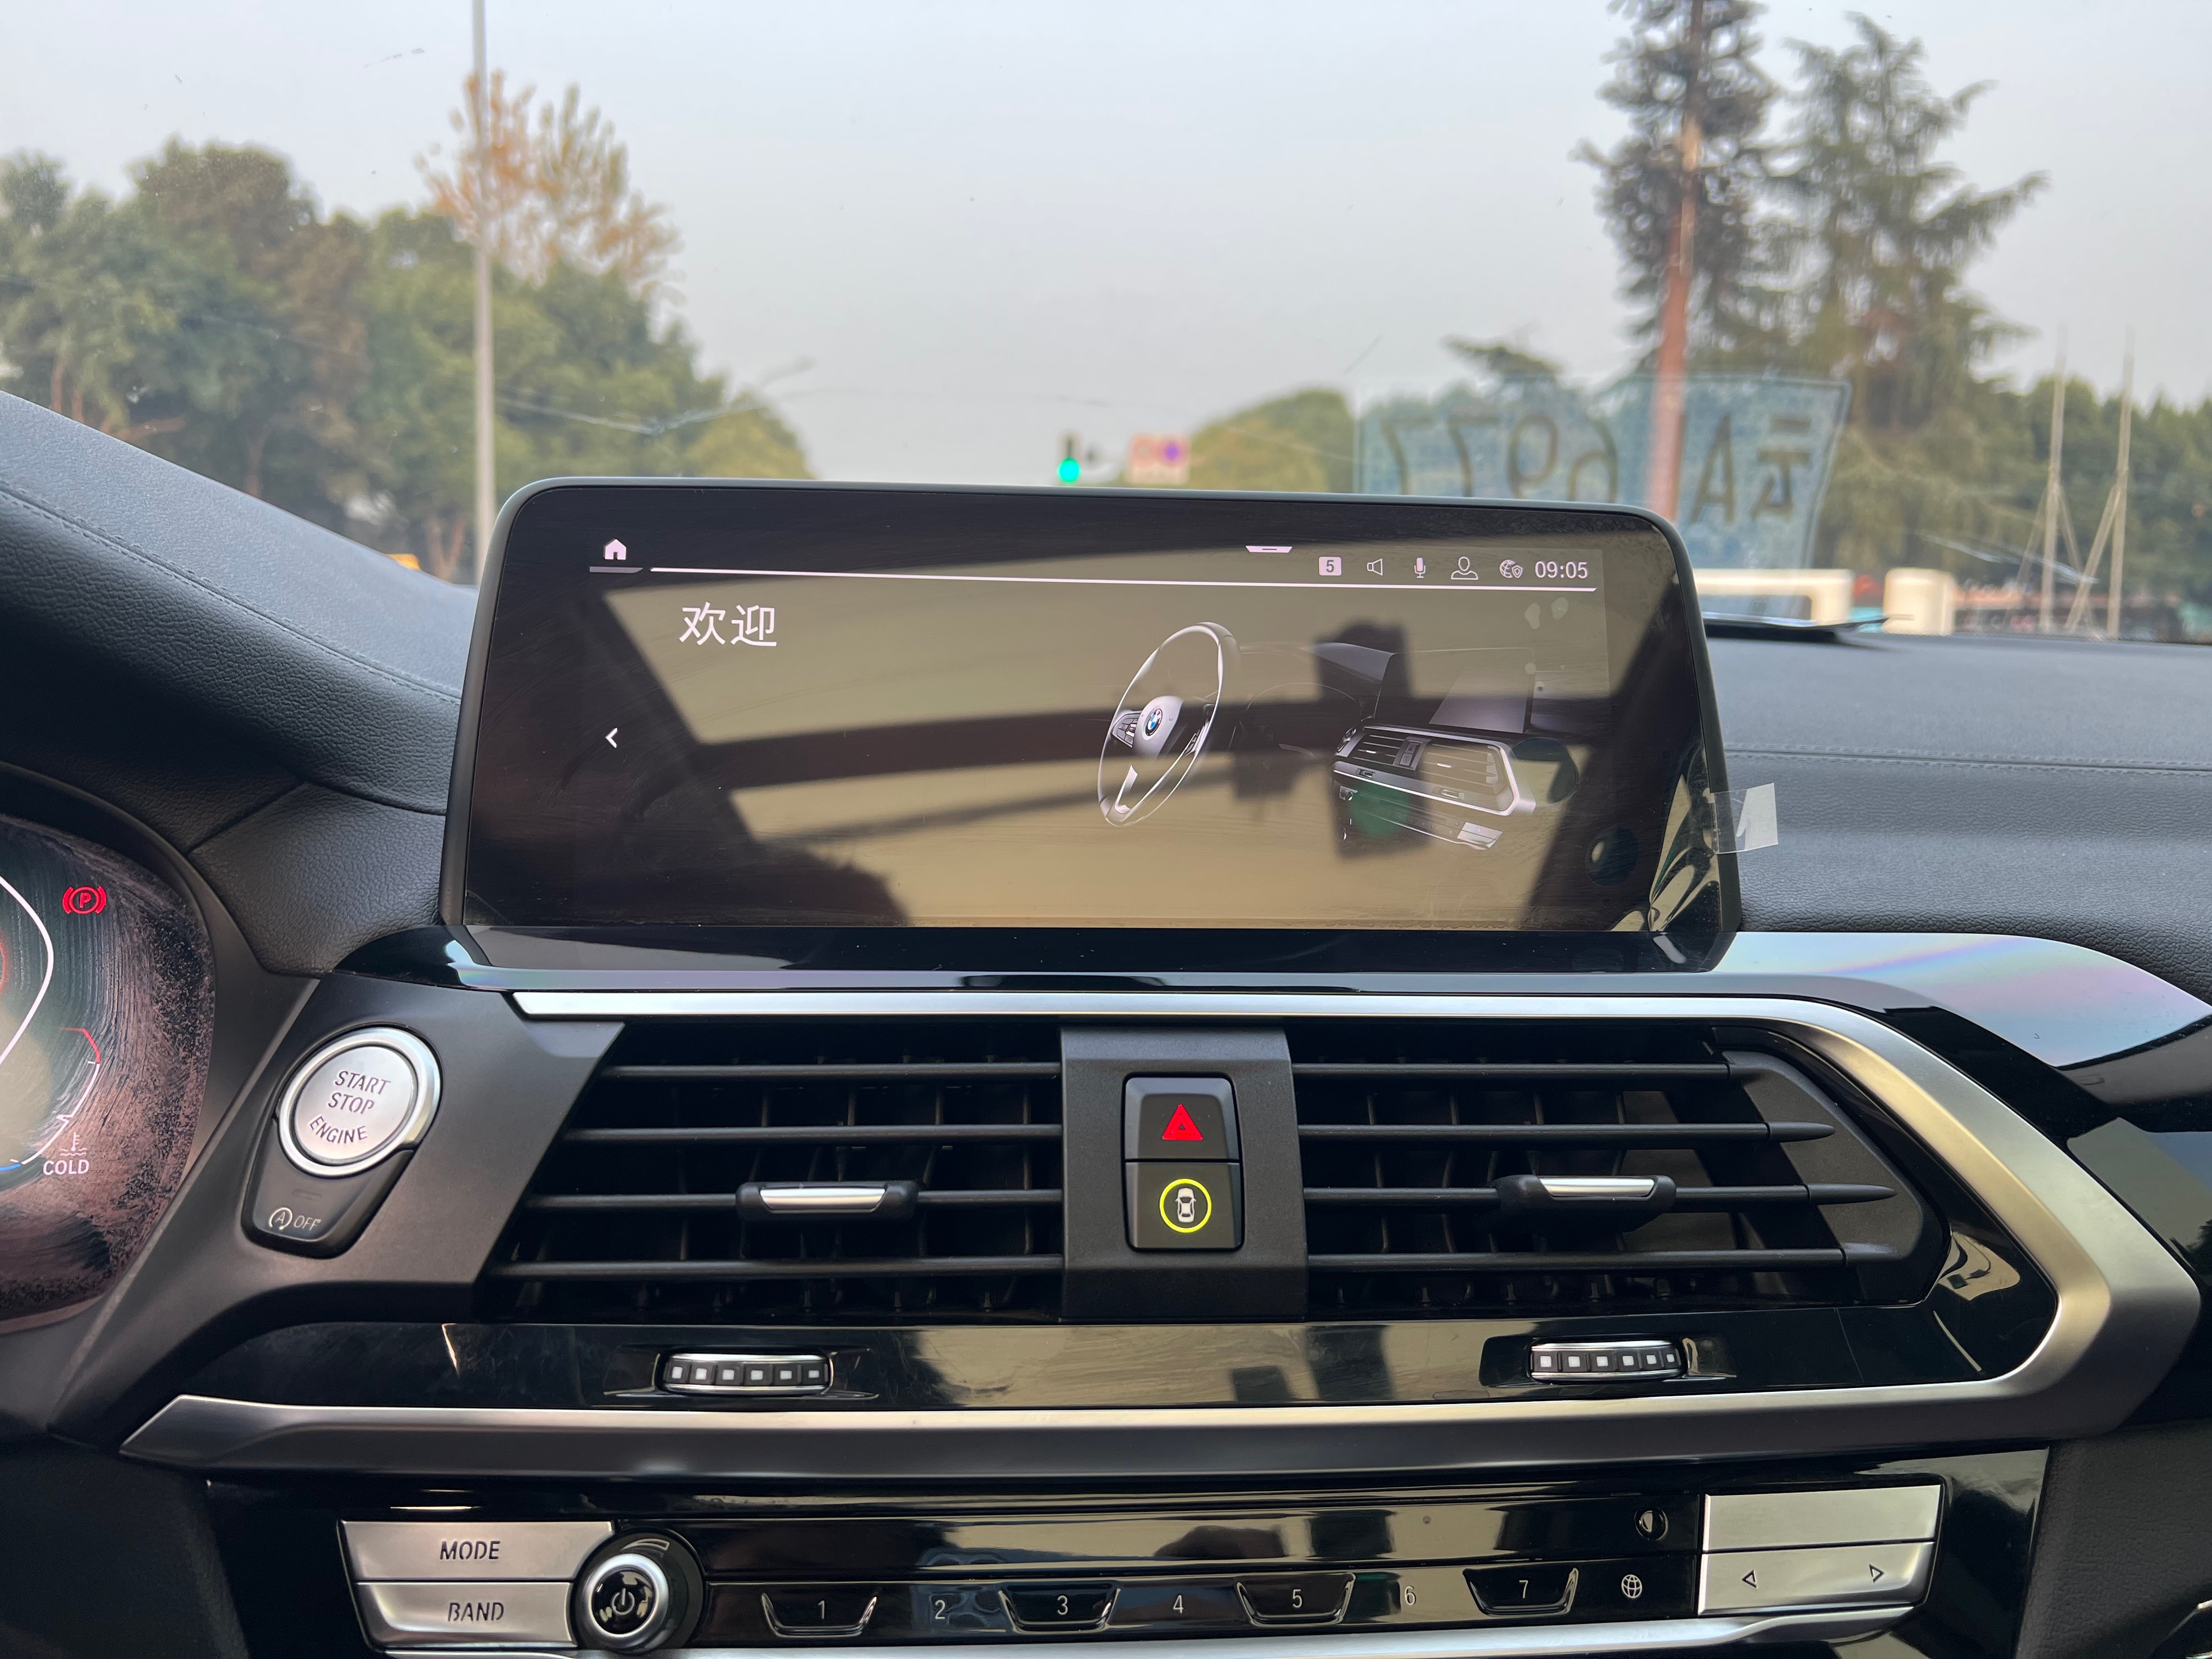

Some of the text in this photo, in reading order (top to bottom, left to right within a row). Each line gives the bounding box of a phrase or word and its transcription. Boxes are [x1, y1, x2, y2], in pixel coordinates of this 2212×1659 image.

[1326, 560, 1334, 573] 5
[1535, 561, 1588, 579] 09:05
[679, 601, 777, 647] 欢迎
[80, 892, 91, 909] P
[334, 1070, 391, 1095] START
[328, 1092, 375, 1115] STOP
[309, 1115, 368, 1144] ENGINE
[43, 1159, 90, 1176] COLD
[275, 1211, 322, 1231] A OFF
[440, 1541, 501, 1560] MODE
[1292, 1589, 1303, 1608] 5
[1404, 1585, 1416, 1606] 6
[1519, 1580, 1529, 1599] 7
[448, 1601, 505, 1622] BAND
[818, 1600, 825, 1619] 1
[935, 1599, 946, 1620] 2
[1057, 1595, 1068, 1615] 3
[1173, 1594, 1184, 1613] 4
